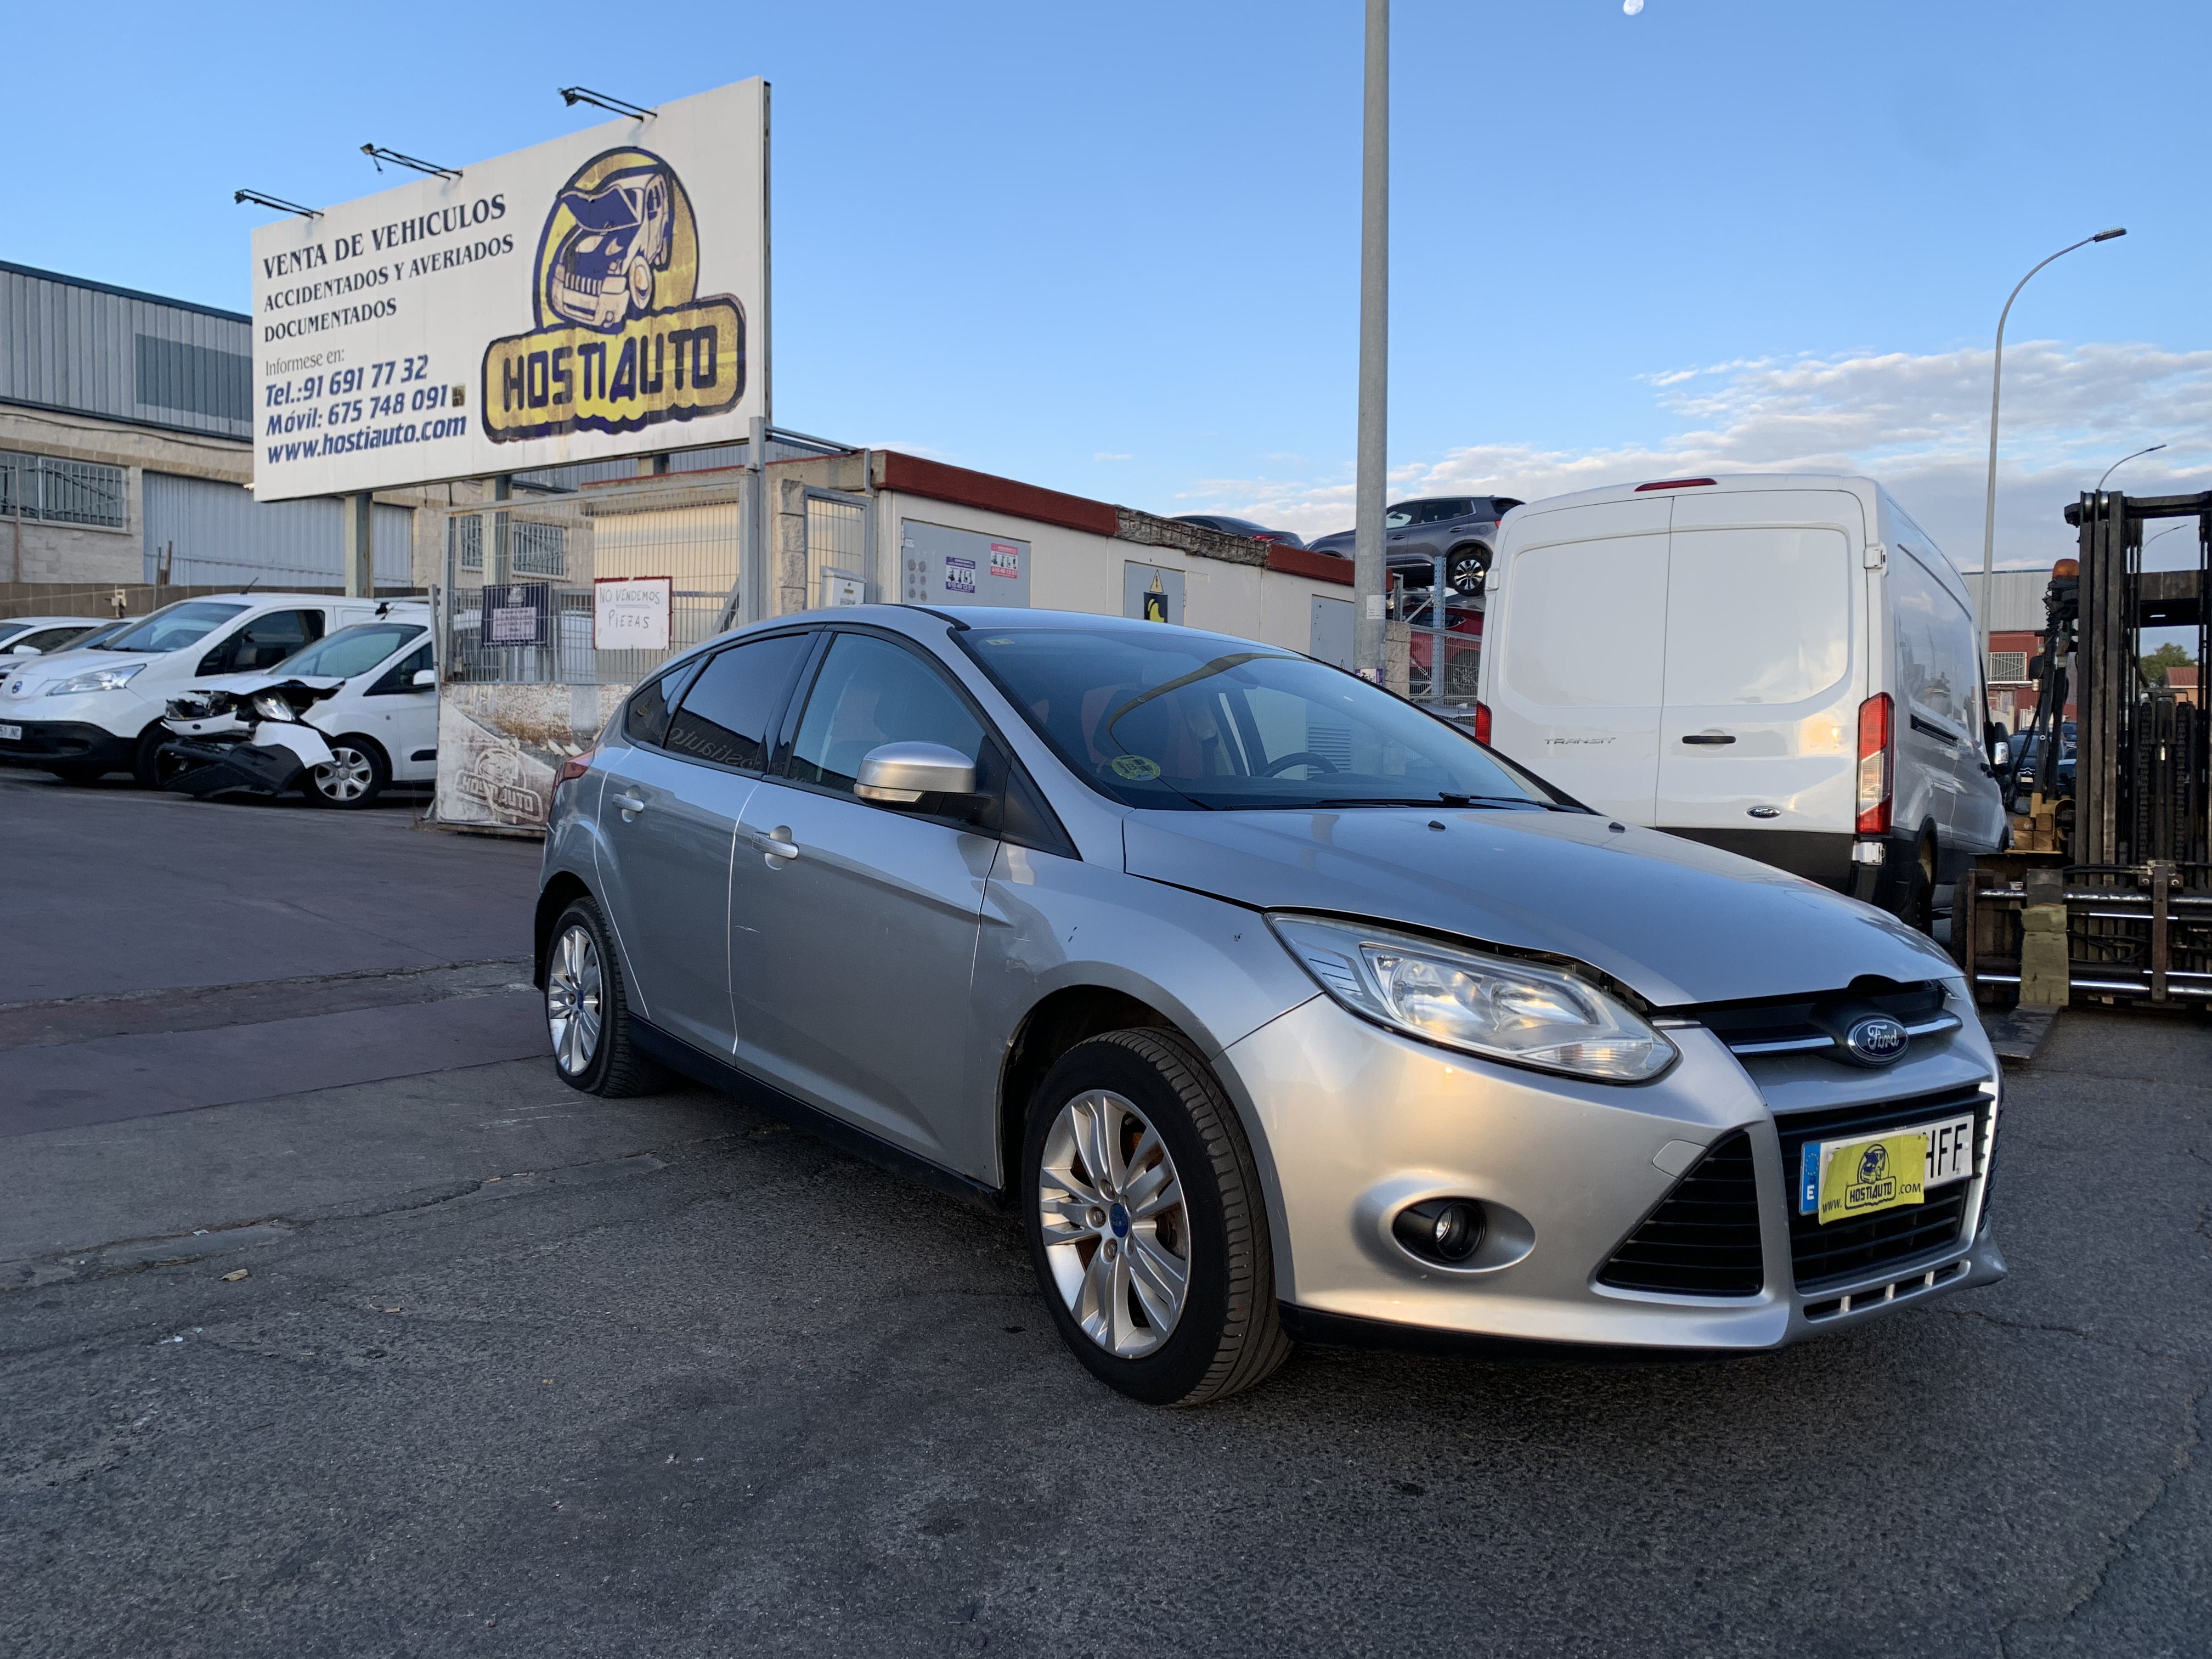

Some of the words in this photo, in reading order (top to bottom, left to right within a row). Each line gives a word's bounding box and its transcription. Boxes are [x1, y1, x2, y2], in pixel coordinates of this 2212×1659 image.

[264, 244, 327, 278] VENTA
[335, 233, 364, 261] DE
[371, 193, 505, 251] VEHICULOS
[264, 266, 388, 312] ACCIDENTADOS
[393, 262, 405, 280] Y
[409, 234, 514, 278] AVERIADOS
[264, 297, 397, 343] DOCUMENTADOS
[327, 348, 345, 364] en:
[503, 325, 718, 412] HOSTIAUTO
[266, 375, 324, 407] Tel.:91
[329, 366, 364, 396] 691
[371, 360, 396, 387] 77
[400, 354, 428, 383] 32
[266, 408, 323, 436] Móvil:
[328, 399, 363, 426] 675
[370, 391, 404, 419] 748
[411, 384, 448, 410] 091
[268, 415, 467, 464] www.hostiauto.com
[599, 587, 613, 604] NO
[616, 588, 660, 605] VENDEMOS
[1867, 1024, 1899, 1051] Ford
[1807, 1185, 1815, 1200] E
[1849, 1181, 1892, 1203] HOSTIAUTO
